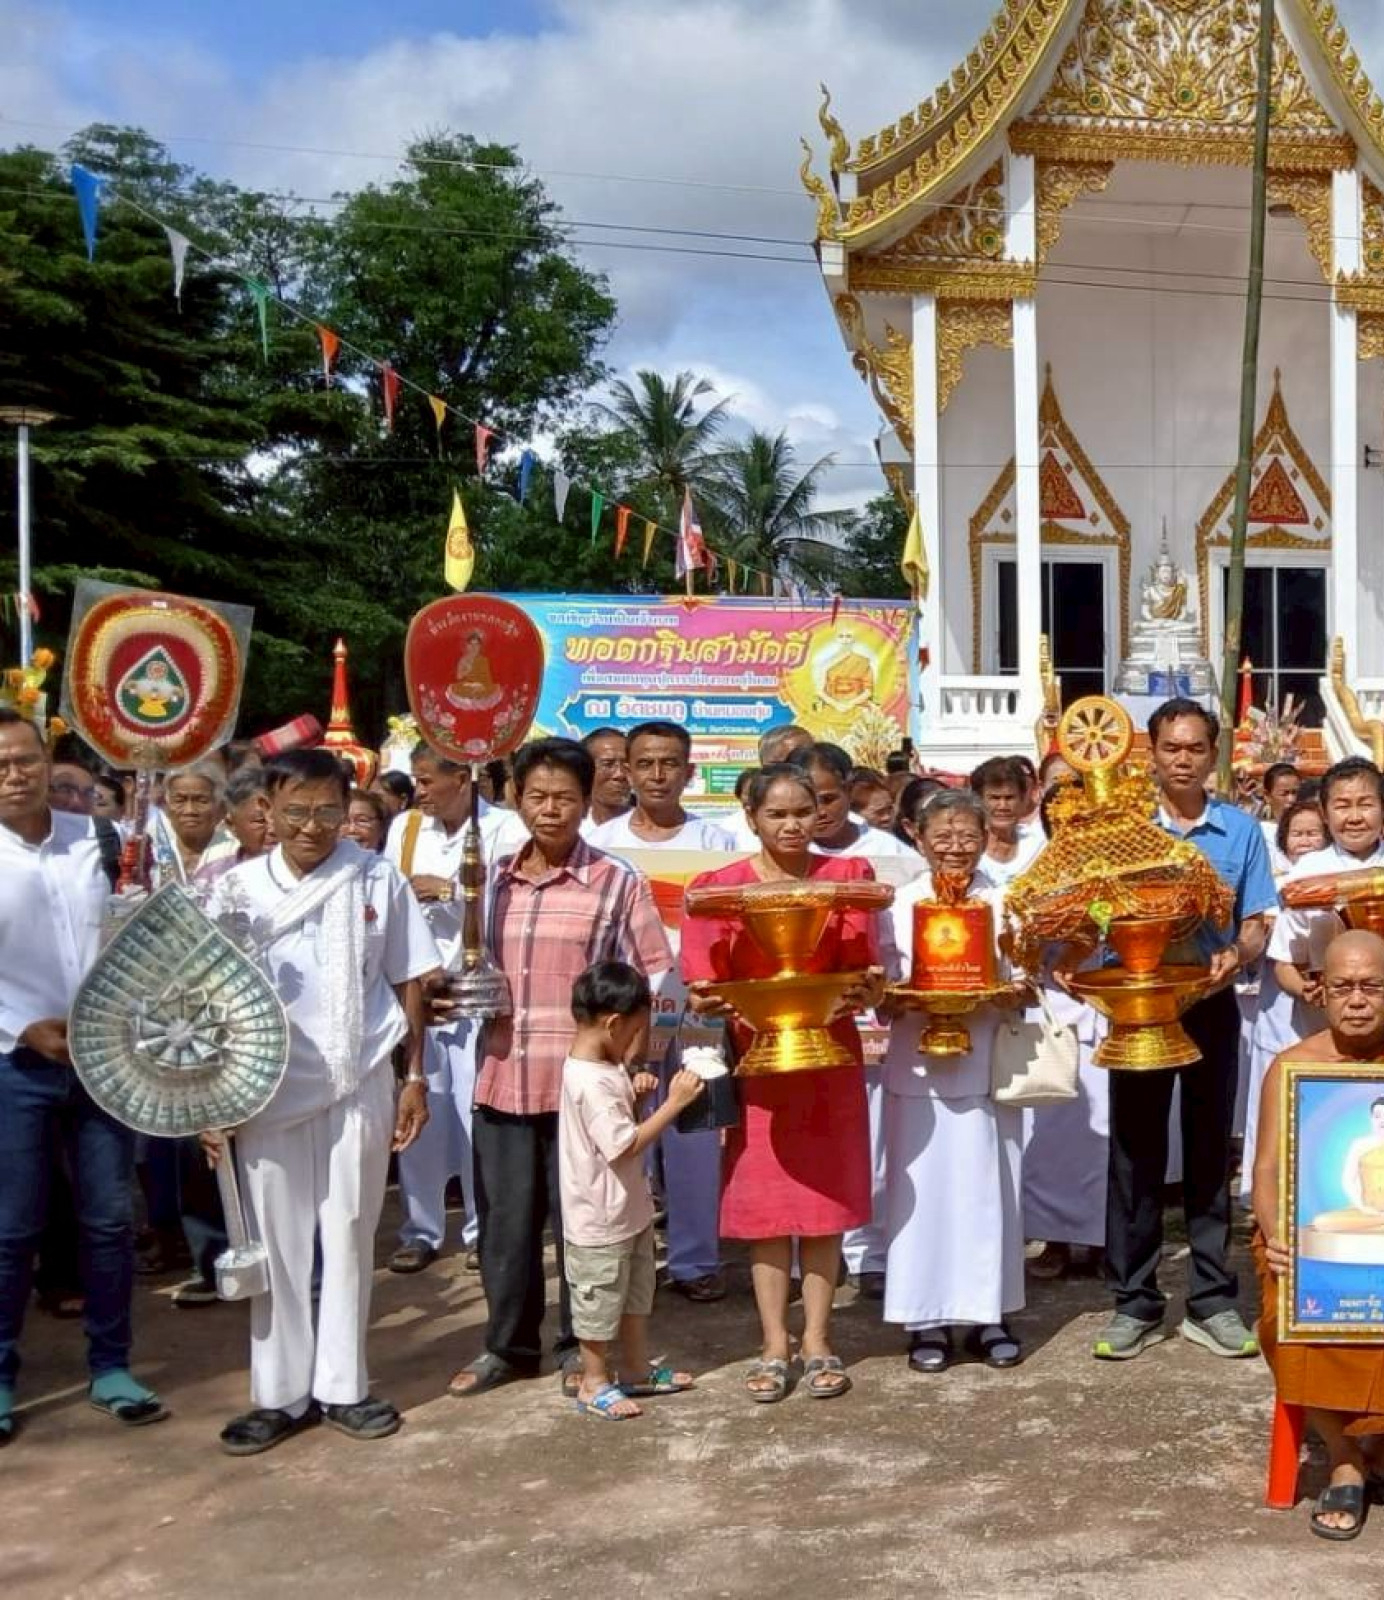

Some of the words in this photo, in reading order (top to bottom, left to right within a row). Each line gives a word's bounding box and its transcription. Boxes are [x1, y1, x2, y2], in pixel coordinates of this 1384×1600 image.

[565, 629, 812, 669] ทอดกฐินสามัคคี
